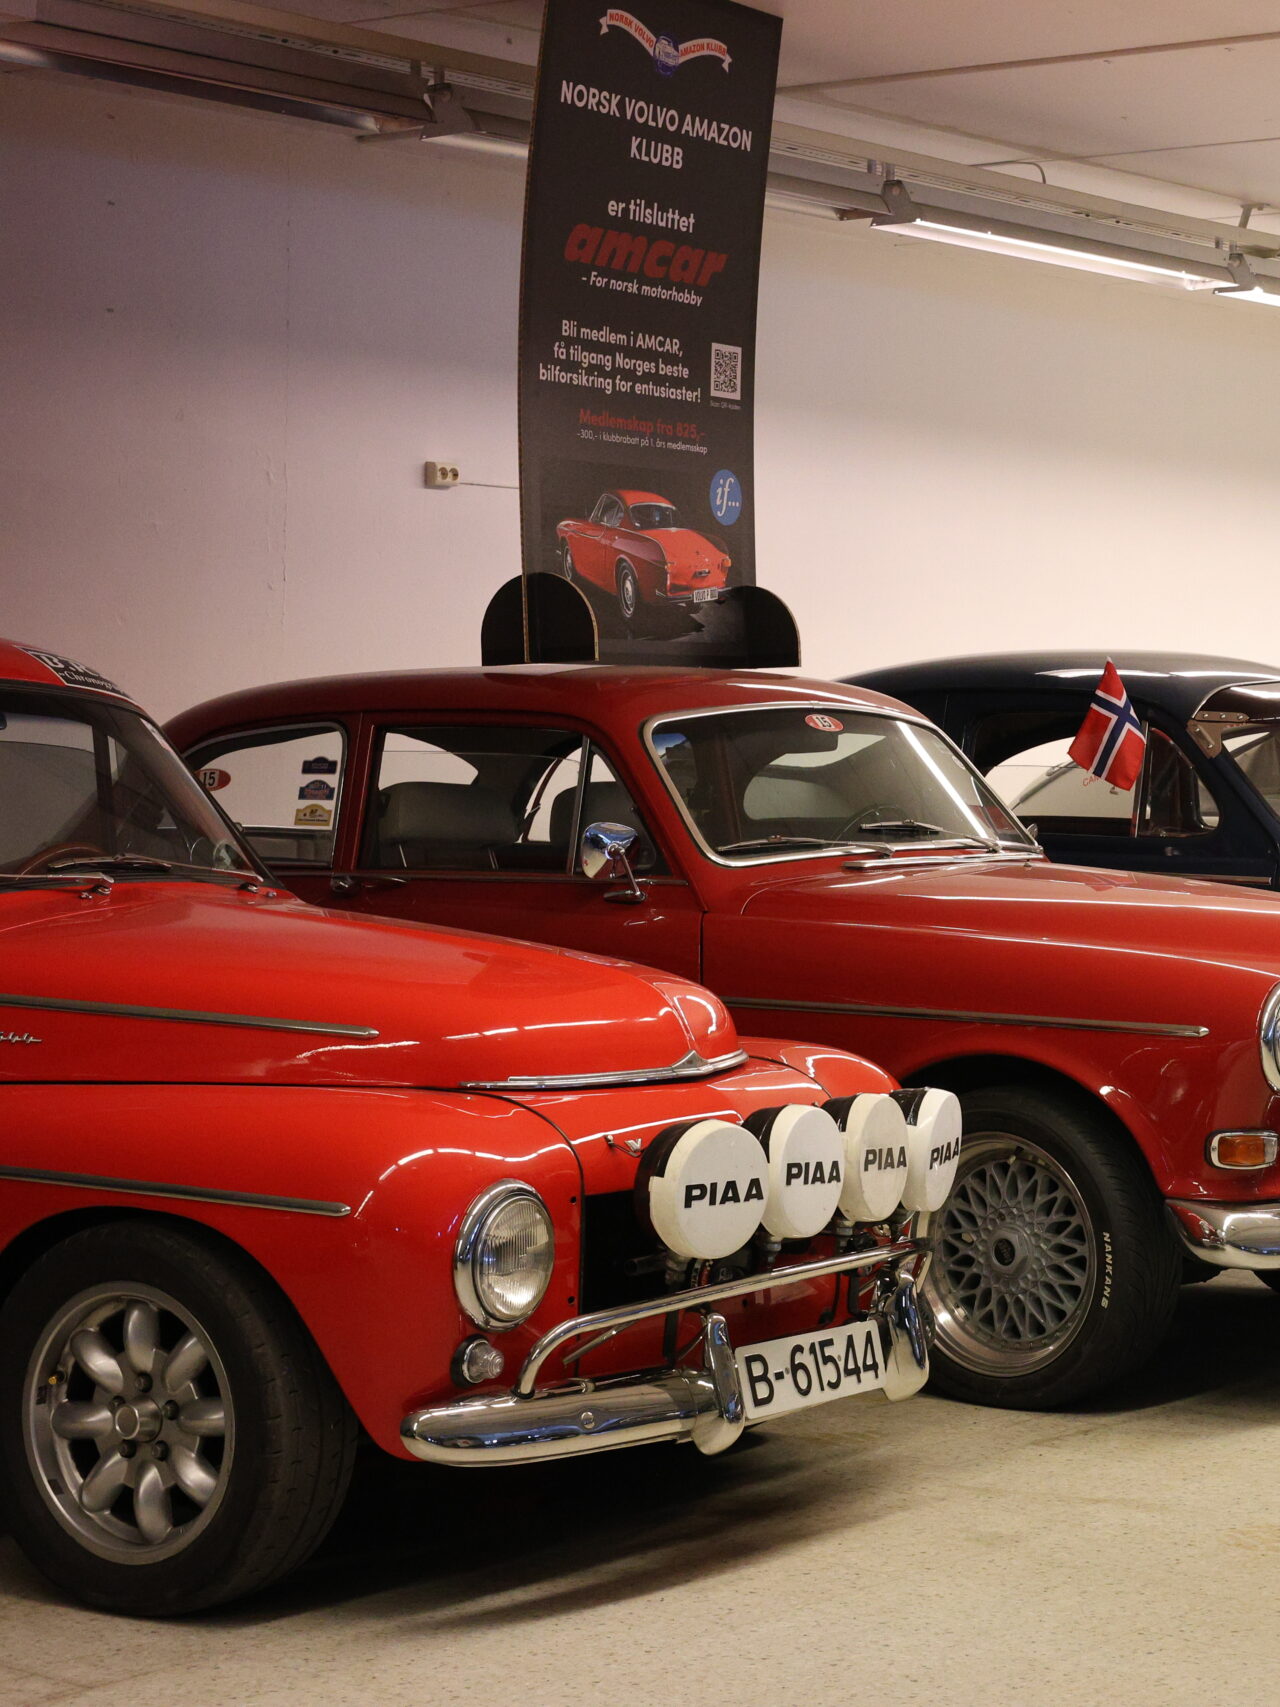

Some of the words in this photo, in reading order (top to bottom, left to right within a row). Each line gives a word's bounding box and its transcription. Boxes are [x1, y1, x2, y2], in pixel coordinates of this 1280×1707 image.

[608, 11, 633, 28] NORSK
[633, 22, 654, 48] VOLVO
[679, 42, 705, 57] AMAZON
[705, 42, 727, 56] KLUBB
[560, 80, 621, 118] NORSK
[625, 97, 679, 132] VOLVO
[681, 114, 752, 152] AMAZON
[630, 136, 683, 169] KLUBB
[608, 200, 625, 217] er
[629, 199, 695, 233] tilsluttet
[564, 223, 729, 287] amcar
[590, 271, 608, 288] For
[610, 279, 639, 294] norsk
[641, 284, 703, 307] motorhobby
[561, 320, 577, 338] Bli
[580, 326, 627, 346] medlem
[630, 332, 634, 346] i
[636, 332, 683, 357] AMCAR,
[553, 340, 567, 360] få
[570, 346, 612, 371] tilgang
[615, 352, 656, 377] Norges
[659, 362, 689, 379] beste
[539, 363, 612, 394] bilforsikring
[615, 375, 632, 393] for
[635, 380, 701, 403] entusiaster!
[578, 408, 654, 437] Medlemskap
[656, 419, 673, 435] fra
[602, 432, 640, 446] klubbrabatt
[640, 437, 649, 448] på
[655, 439, 667, 449] års
[815, 716, 832, 728] 15
[203, 771, 216, 787] 15
[864, 1146, 908, 1172] PIAA
[930, 1137, 960, 1170] PIAA
[785, 1160, 842, 1187] PIAA
[684, 1177, 765, 1209] PIAA
[1100, 1231, 1114, 1310] NANKANG
[745, 1330, 880, 1408] B-61544
